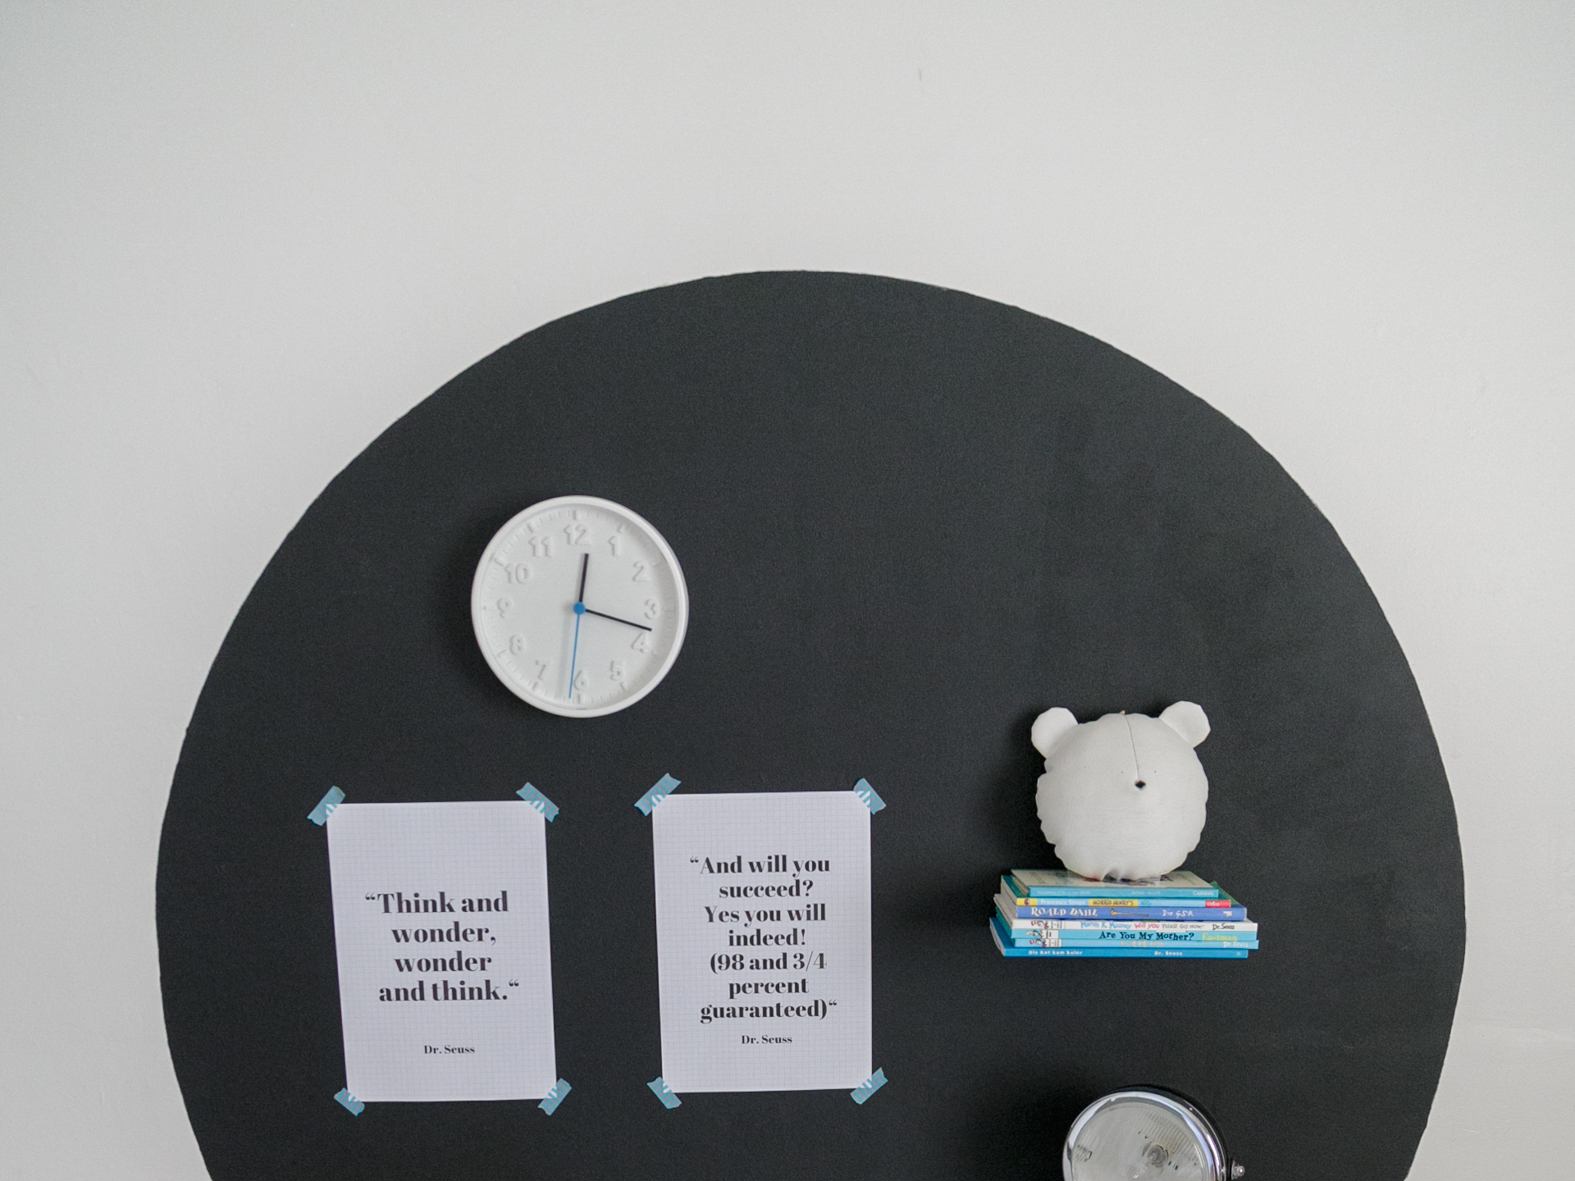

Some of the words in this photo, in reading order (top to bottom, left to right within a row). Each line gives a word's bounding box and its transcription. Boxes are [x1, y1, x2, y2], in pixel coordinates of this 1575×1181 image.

[563, 523, 591, 547] 12
[528, 536, 554, 558] 11
[607, 536, 620, 556] 1
[504, 563, 530, 584] 10
[631, 561, 649, 583] 2
[496, 598, 512, 618] 9
[644, 598, 659, 620] 3
[508, 634, 525, 655] 8
[630, 632, 651, 653] 4
[535, 660, 553, 681] 7
[572, 670, 590, 690] 6
[610, 660, 626, 681] 5
[690, 856, 743, 874] “And
[748, 855, 788, 873] will
[792, 858, 830, 877] you
[719, 880, 813, 898] succeed?
[365, 891, 455, 914] “Think
[461, 890, 509, 912] and
[1031, 907, 1066, 916] ROALD
[1070, 908, 1098, 916] DAHL
[704, 906, 740, 923] Yes
[744, 907, 781, 927] you
[788, 904, 826, 922] will
[1176, 910, 1194, 918] GSR
[391, 921, 497, 944] wonder,
[1109, 921, 1131, 930] Mooney
[1156, 932, 1194, 940] Mother?
[728, 928, 806, 946] indeed!
[394, 950, 492, 972] wonder
[710, 953, 744, 975] (98
[750, 953, 788, 970] and
[793, 951, 827, 971] 3/4
[379, 981, 425, 1001] and
[728, 978, 809, 999] percent
[424, 1044, 442, 1054] Dr.
[444, 1045, 475, 1054] Seuss
[741, 1035, 759, 1044] Dr.
[761, 1035, 793, 1044] Seuss
